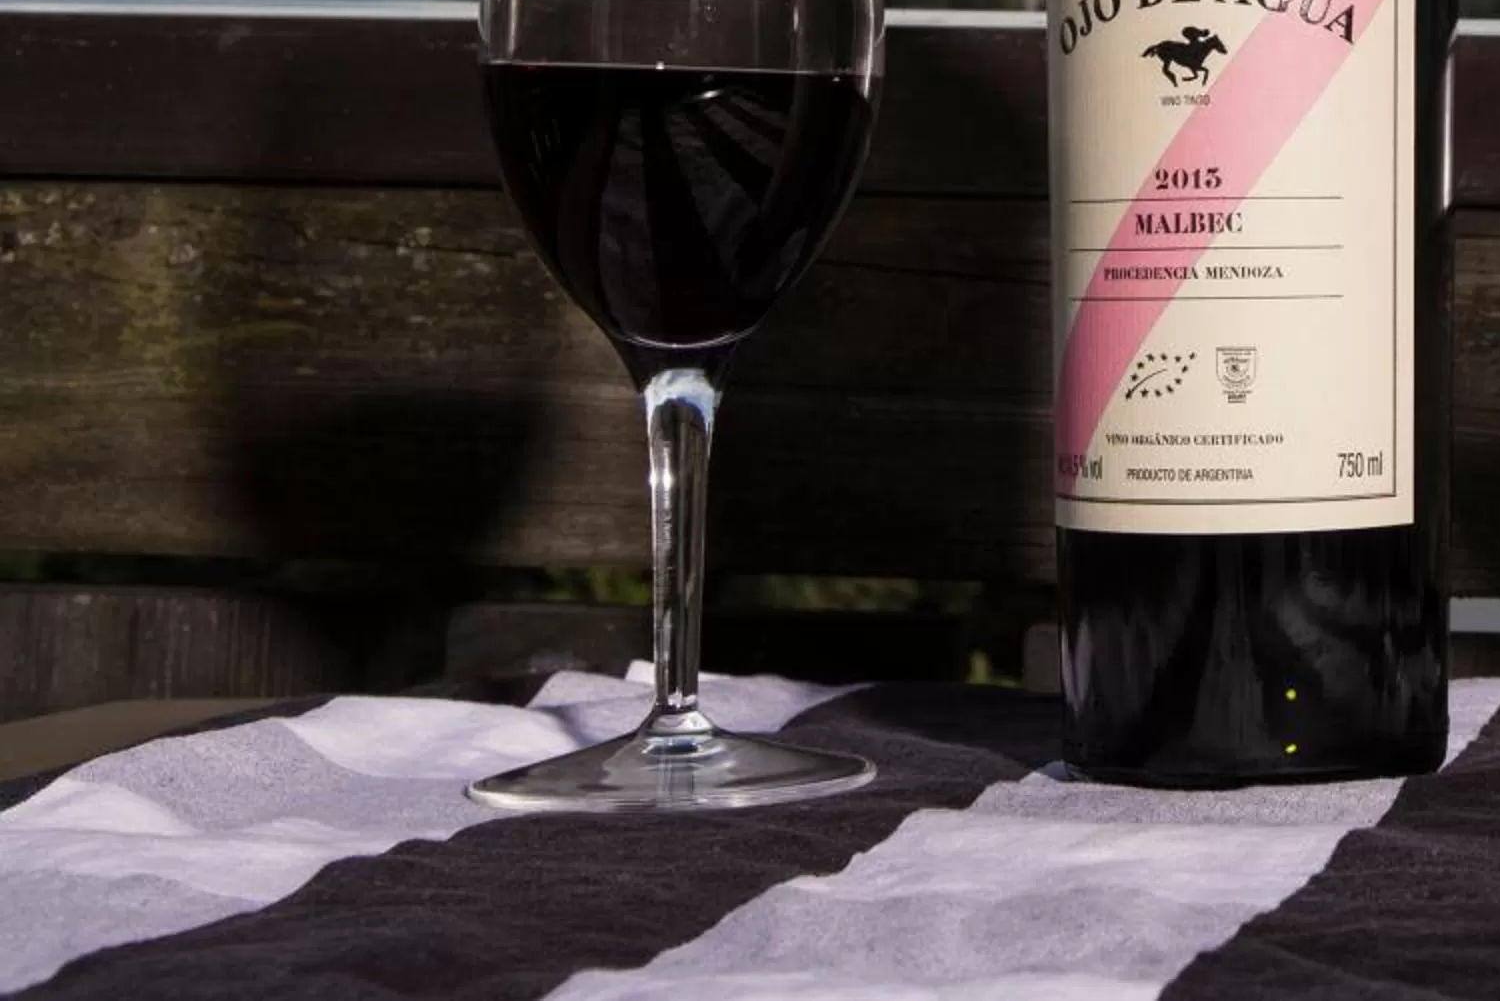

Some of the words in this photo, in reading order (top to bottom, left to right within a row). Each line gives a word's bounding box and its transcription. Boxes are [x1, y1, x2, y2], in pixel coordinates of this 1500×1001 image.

[1155, 167, 1222, 190] 2015
[1135, 212, 1243, 235] MALBEC
[1103, 266, 1199, 280] PROCEDENCIA
[1205, 265, 1284, 279] MENDOZA
[1105, 433, 1129, 446] VINO
[1193, 433, 1284, 446] CERTIFICADO
[1337, 452, 1365, 478] 750
[1367, 450, 1383, 477] ml
[1126, 468, 1176, 482] PRODUCTO
[1178, 469, 1192, 482] DE
[1193, 468, 1254, 481] ARGENTINA
